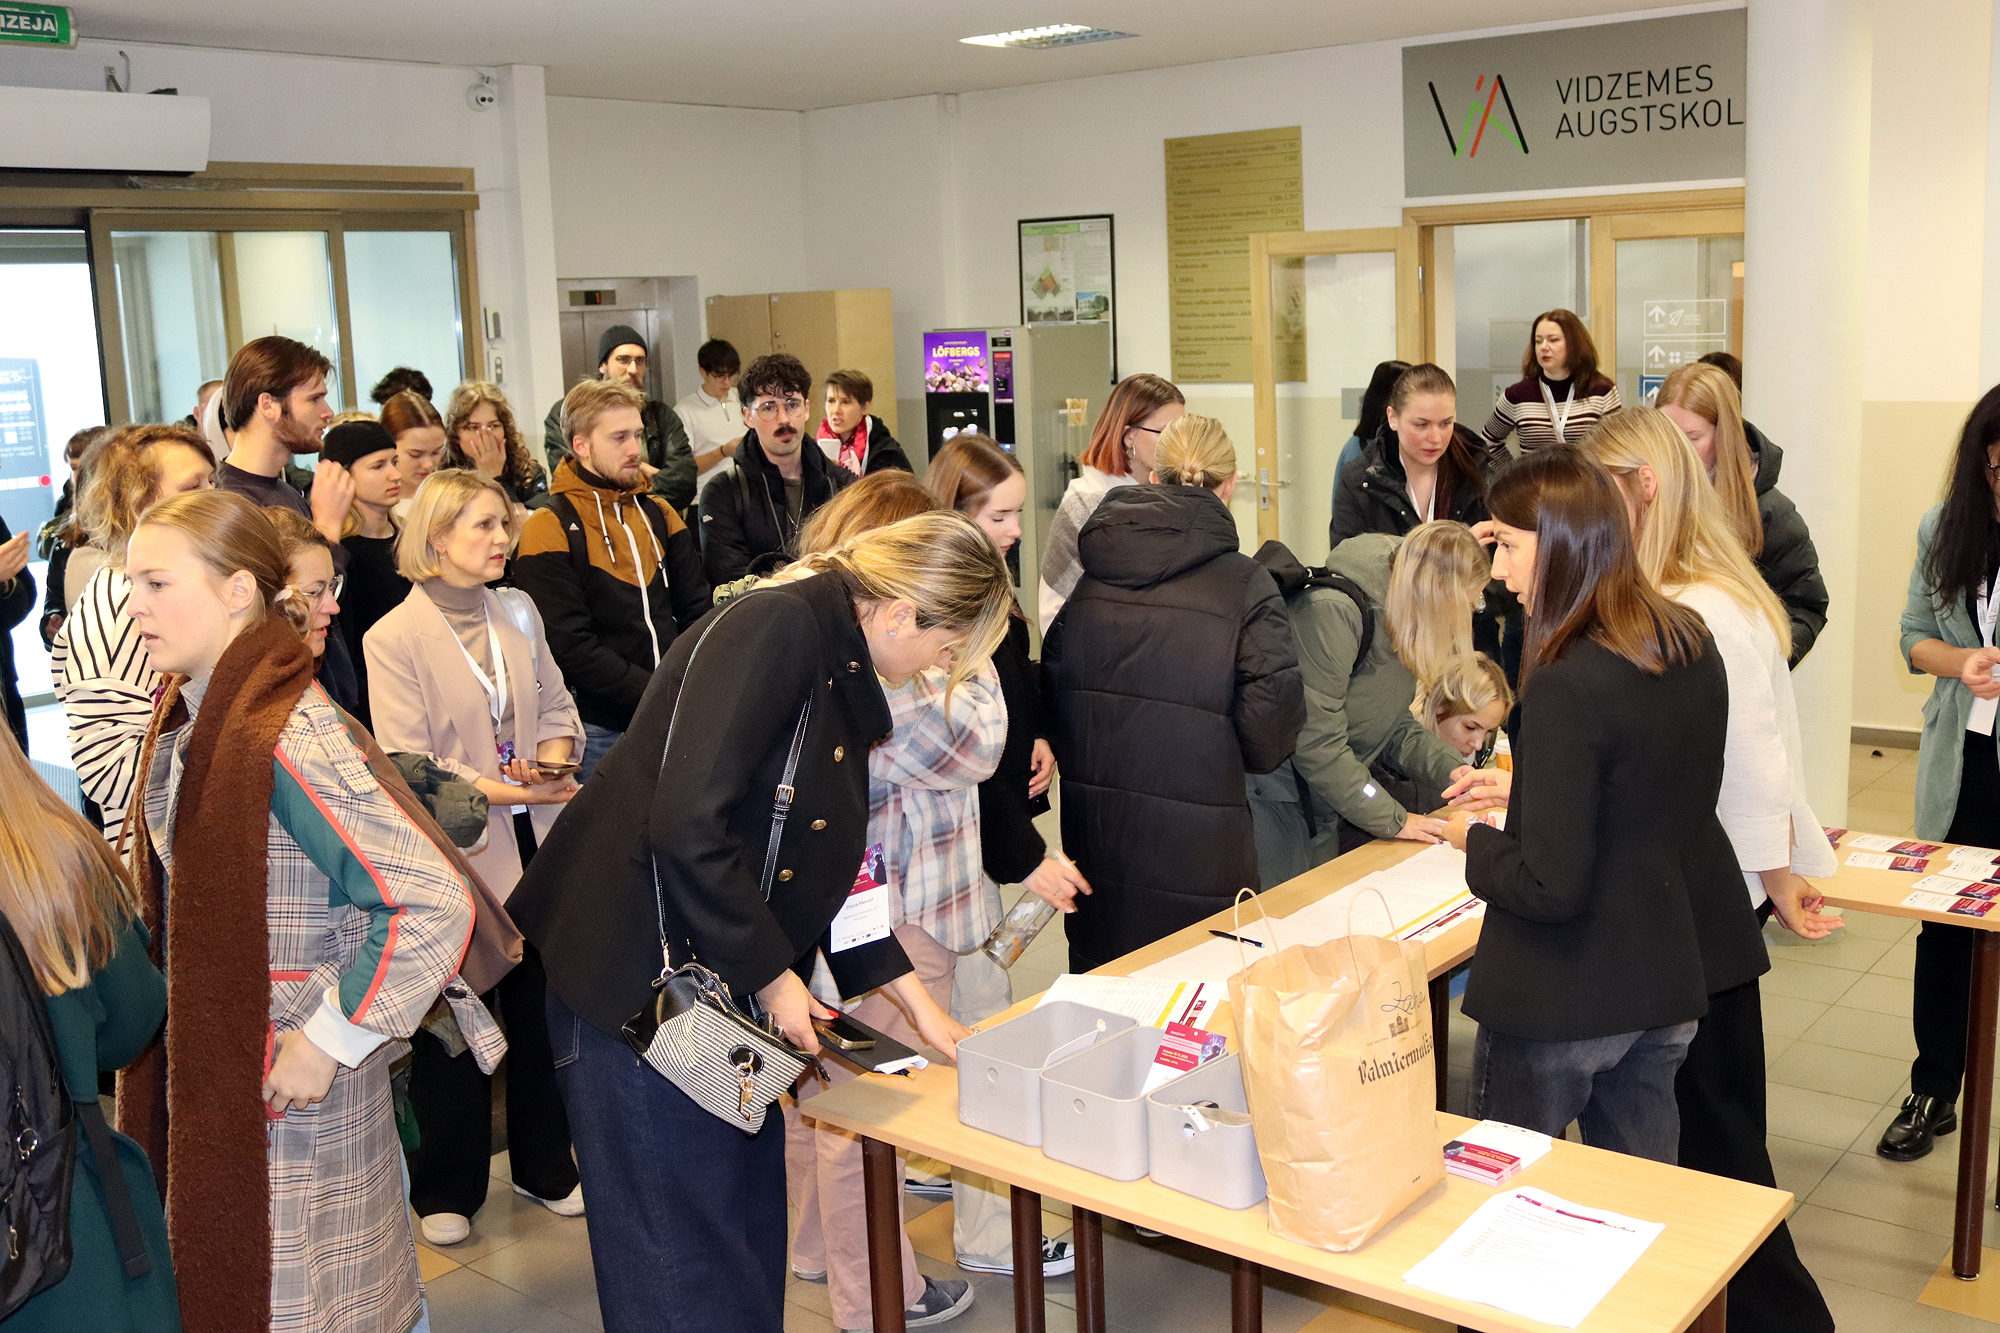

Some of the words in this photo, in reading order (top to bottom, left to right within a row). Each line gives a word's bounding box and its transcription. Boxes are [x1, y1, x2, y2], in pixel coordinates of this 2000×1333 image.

[0, 14, 56, 32] IZEJA
[1555, 64, 1714, 105] VIDZEMES
[1555, 98, 1744, 139] AUGSTSKOL
[932, 345, 981, 358] LÖFBERGS
